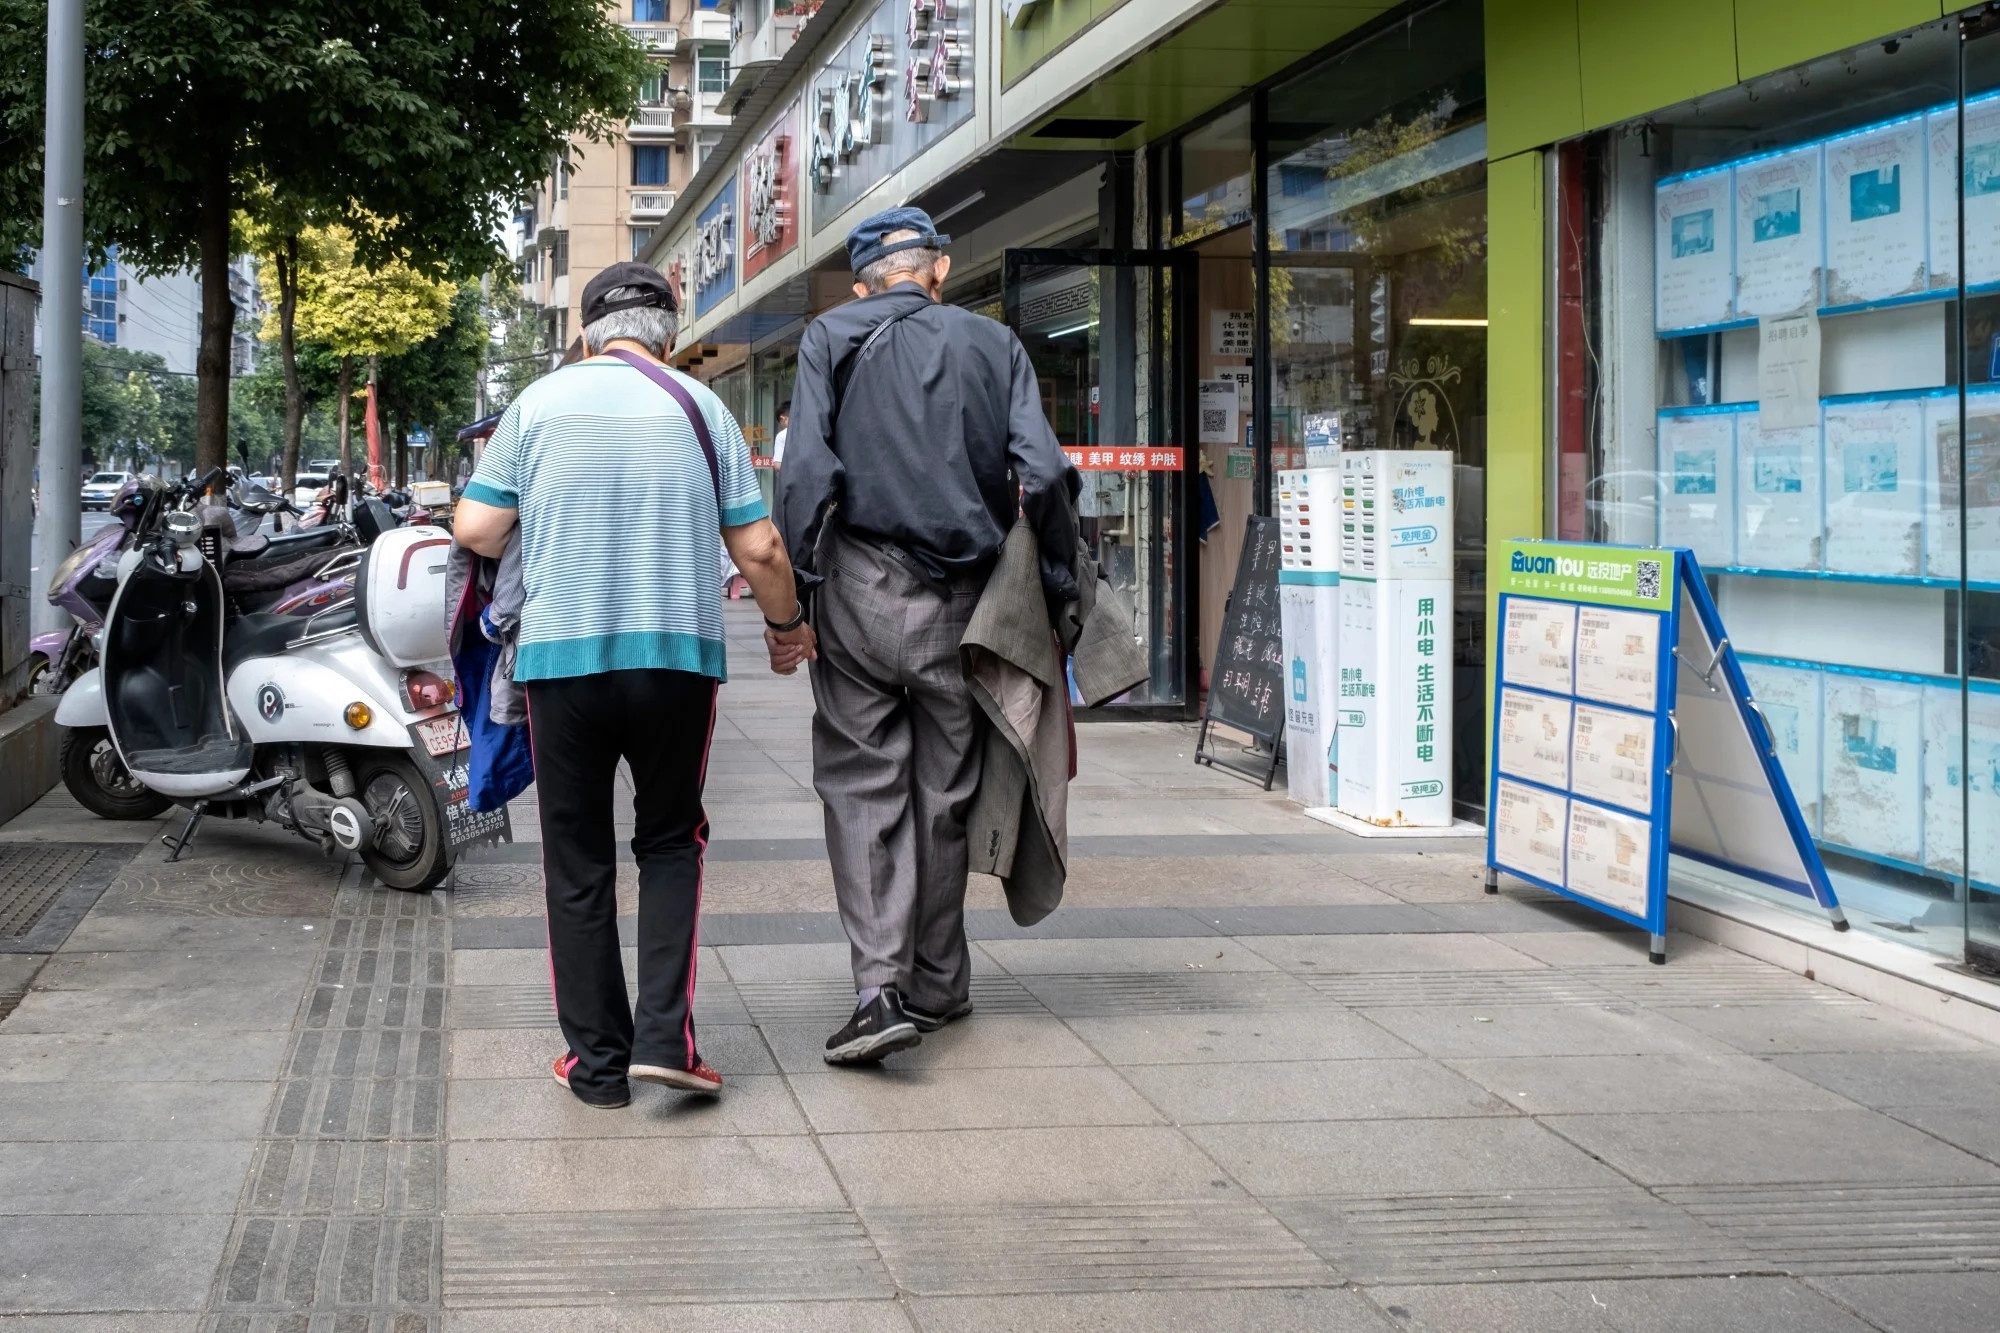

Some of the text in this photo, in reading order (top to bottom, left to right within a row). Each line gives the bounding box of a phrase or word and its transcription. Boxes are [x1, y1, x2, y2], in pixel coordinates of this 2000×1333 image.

[1088, 452, 1114, 466] 美甲
[1119, 452, 1146, 467] 纹绣
[1150, 452, 1177, 467] 护肤
[1401, 529, 1431, 542] 免押金
[1341, 668, 1362, 682] 用小电
[1416, 598, 1434, 763] 用小电 生活不断电
[1341, 683, 1375, 697] 生活不断电
[1349, 713, 1363, 724] 免押金
[451, 789, 469, 800] ARM
[1411, 783, 1439, 795] 免押金
[451, 815, 504, 839] 81454300
